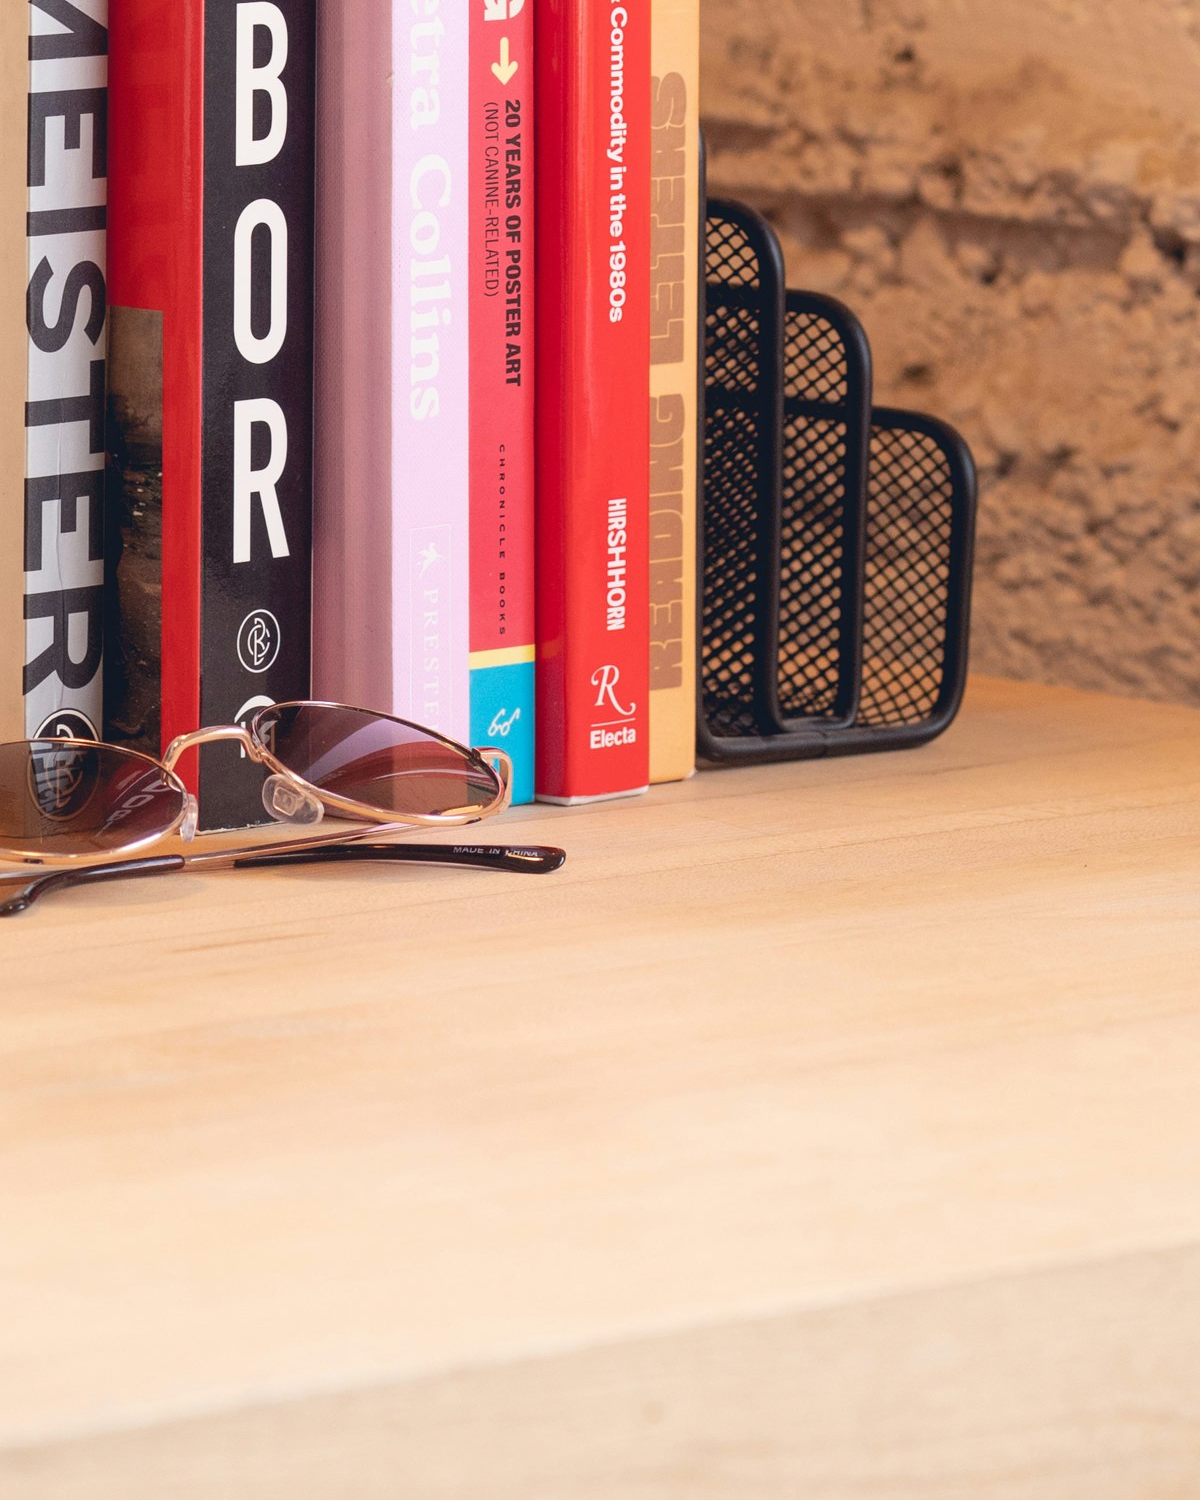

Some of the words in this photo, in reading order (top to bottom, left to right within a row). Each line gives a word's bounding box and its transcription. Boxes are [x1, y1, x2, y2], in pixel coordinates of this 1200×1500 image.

[505, 99, 521, 128] 20
[606, 7, 628, 163] Commodity
[484, 101, 500, 141] (NOT
[505, 133, 521, 209] YEARS
[610, 167, 627, 190] in
[484, 147, 500, 298] CANINE-RELATED)
[505, 214, 521, 243] OF
[609, 194, 627, 237] the
[649, 72, 688, 365] LETTERS
[410, 154, 452, 421] Collins
[505, 249, 521, 337] POSTER
[609, 241, 627, 323] 1980s
[505, 343, 521, 387] ART
[606, 498, 628, 632] HIRSHHORN
[649, 393, 686, 691] READING
[591, 664, 637, 716] R
[590, 727, 637, 750] Electa
[453, 846, 485, 855] MADE
